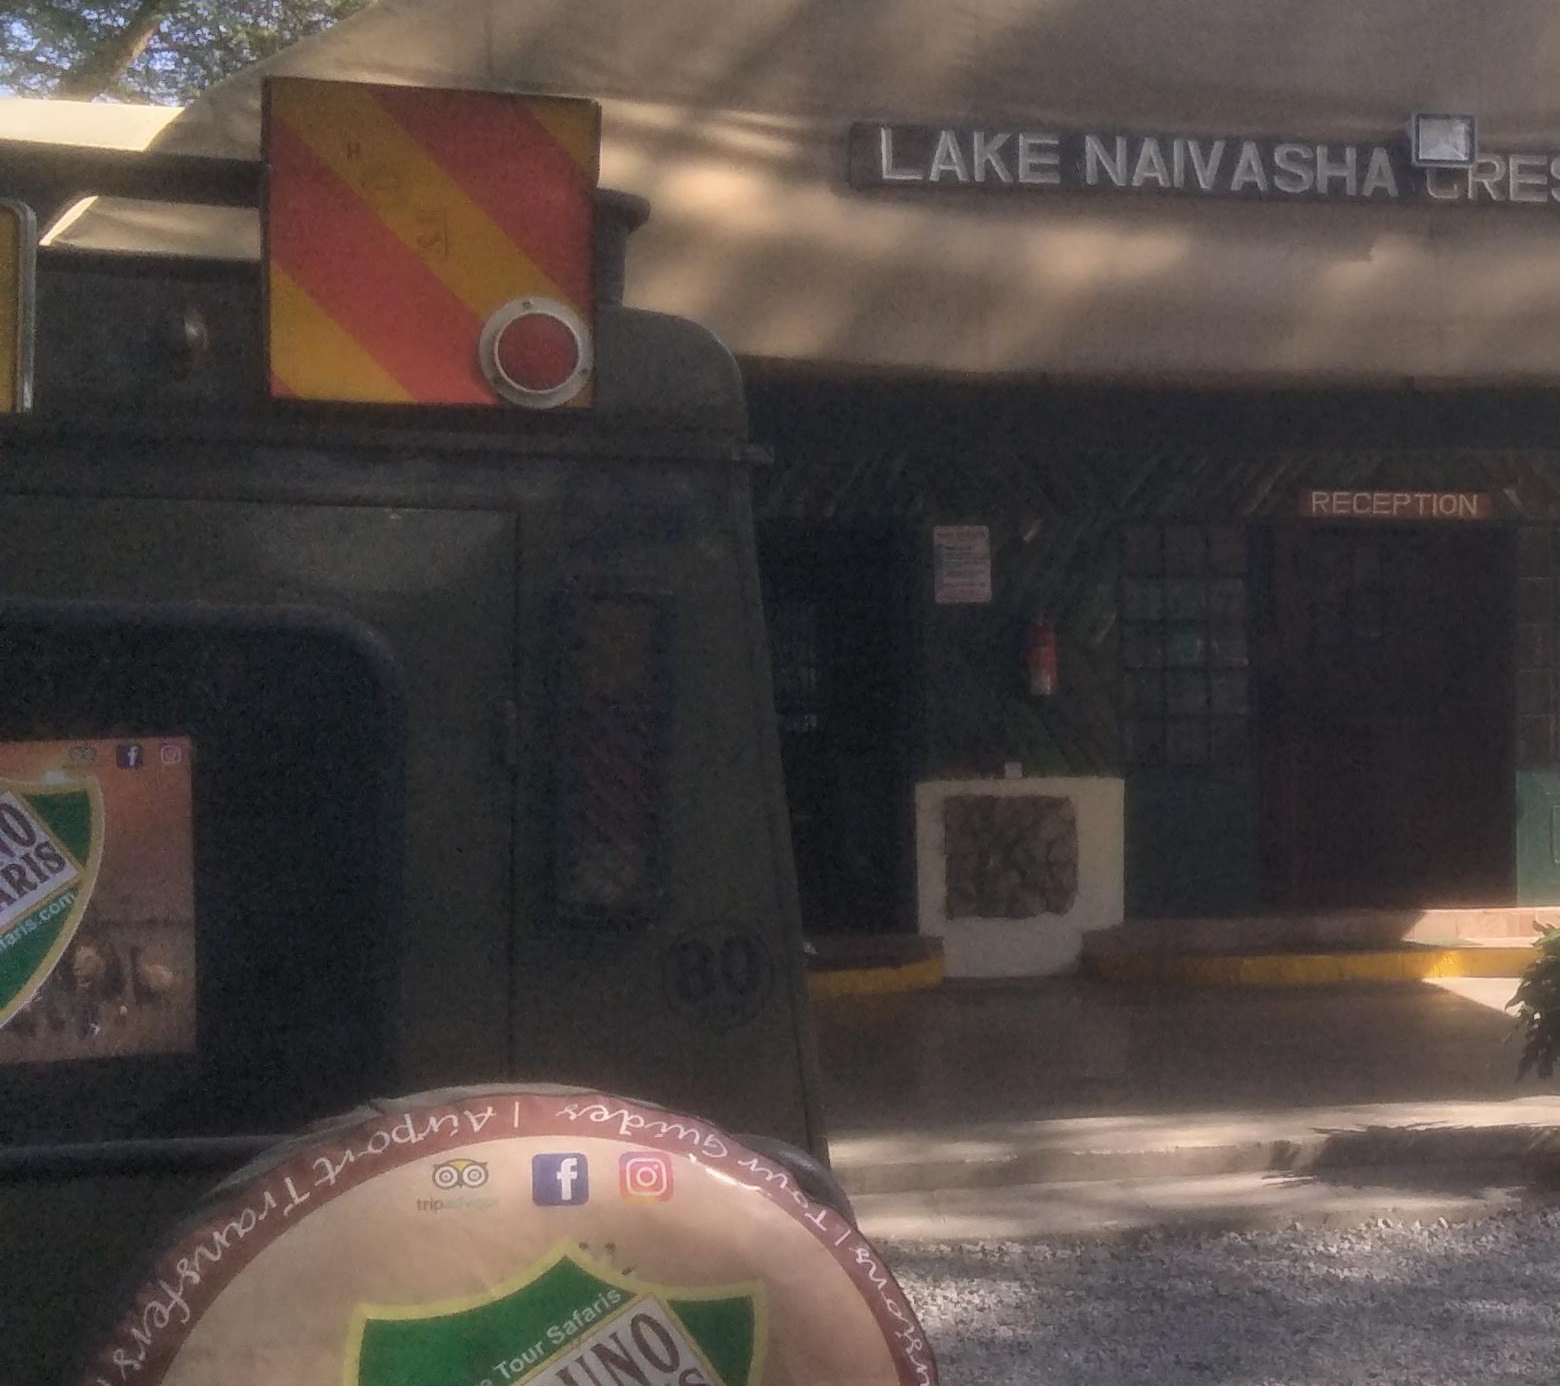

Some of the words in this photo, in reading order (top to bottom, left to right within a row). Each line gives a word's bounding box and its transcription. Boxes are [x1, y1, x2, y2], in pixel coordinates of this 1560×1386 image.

[881, 127, 1061, 184] LAKE
[1084, 134, 1399, 198] NAIVASHA
[1311, 491, 1478, 517] RECEPTION
[313, 1107, 498, 1186] Airport
[557, 1103, 729, 1160] Guides
[737, 1156, 828, 1232] Tour
[112, 1177, 311, 1381] Transfers
[494, 1341, 545, 1380] Tour
[546, 1288, 622, 1345] Safaris
